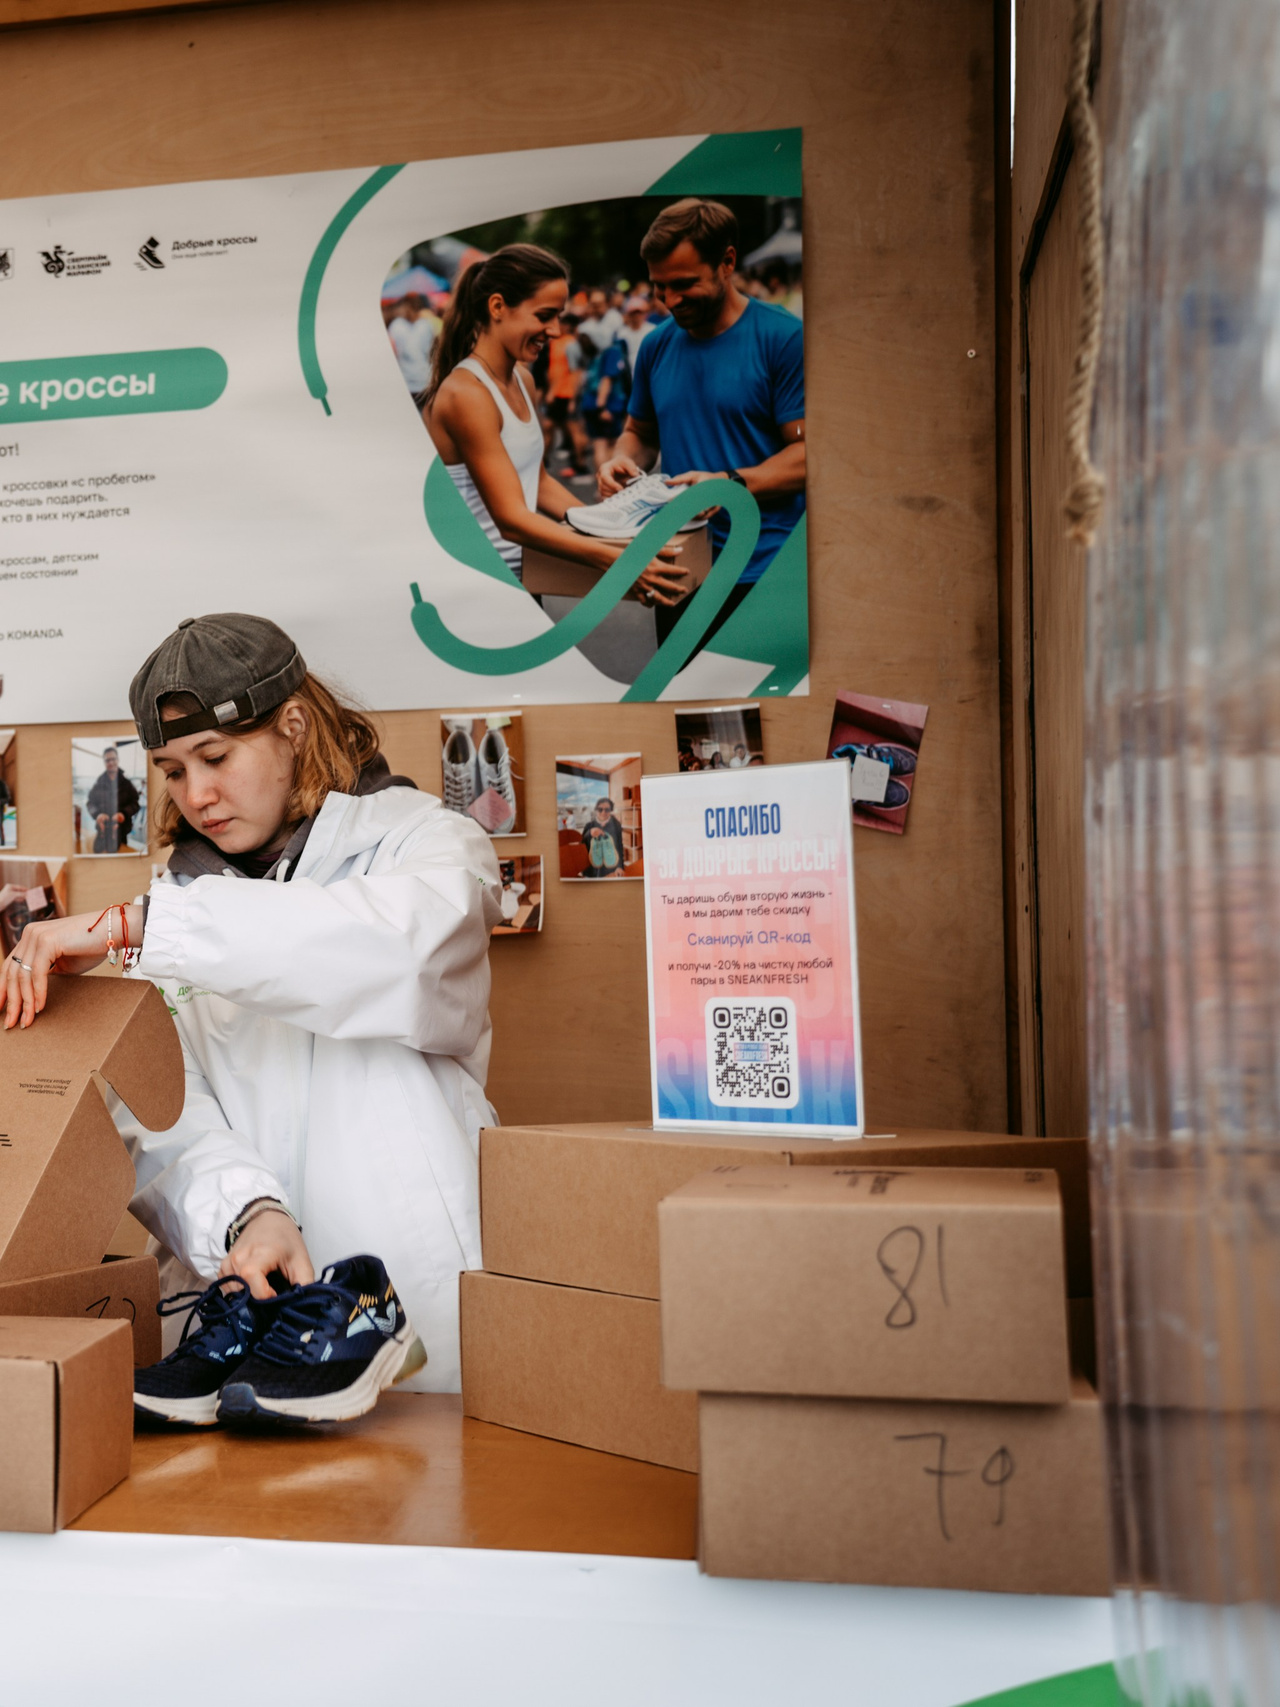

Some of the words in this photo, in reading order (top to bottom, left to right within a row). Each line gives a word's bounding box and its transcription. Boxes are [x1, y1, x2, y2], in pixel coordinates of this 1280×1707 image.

[172, 240, 213, 251] Добрые
[217, 236, 257, 247] кроссы
[19, 373, 156, 410] кроссы
[3, 479, 68, 493] кроссовки
[71, 478, 85, 487] «с
[88, 473, 156, 488] пробегом»
[46, 492, 108, 508] подарить.
[2, 513, 22, 523] кто
[26, 513, 33, 522] в
[36, 511, 58, 521] них
[61, 506, 131, 521] нуждается
[0, 556, 49, 567] кроссам,
[52, 553, 99, 564] детским
[20, 569, 79, 579] состоянии
[7, 628, 64, 640] KOMANDA
[705, 803, 781, 838] СПАСИБО
[658, 848, 678, 879] ЗА
[682, 843, 753, 880] ДОБРЫЕ
[757, 838, 837, 873] КРОССЫ!
[661, 895, 674, 904] Ты
[677, 895, 715, 905] даришь
[717, 891, 747, 904] обуви
[750, 893, 788, 904] вторую
[791, 890, 825, 900] жизнь
[692, 910, 707, 918] мы
[709, 908, 743, 919] дарим
[745, 905, 770, 916] тебе
[773, 905, 811, 917] скидку
[687, 931, 754, 948] Сканируй
[757, 931, 811, 944] QR-код
[668, 963, 674, 971] и
[676, 962, 711, 973] получи
[714, 960, 740, 971] -20%
[759, 961, 794, 972] чистку
[797, 958, 833, 969] любой
[691, 977, 716, 987] пары
[727, 974, 808, 985] SNEAKNFRESH
[877, 1224, 950, 1329] 81
[893, 1432, 1016, 1542] 79
